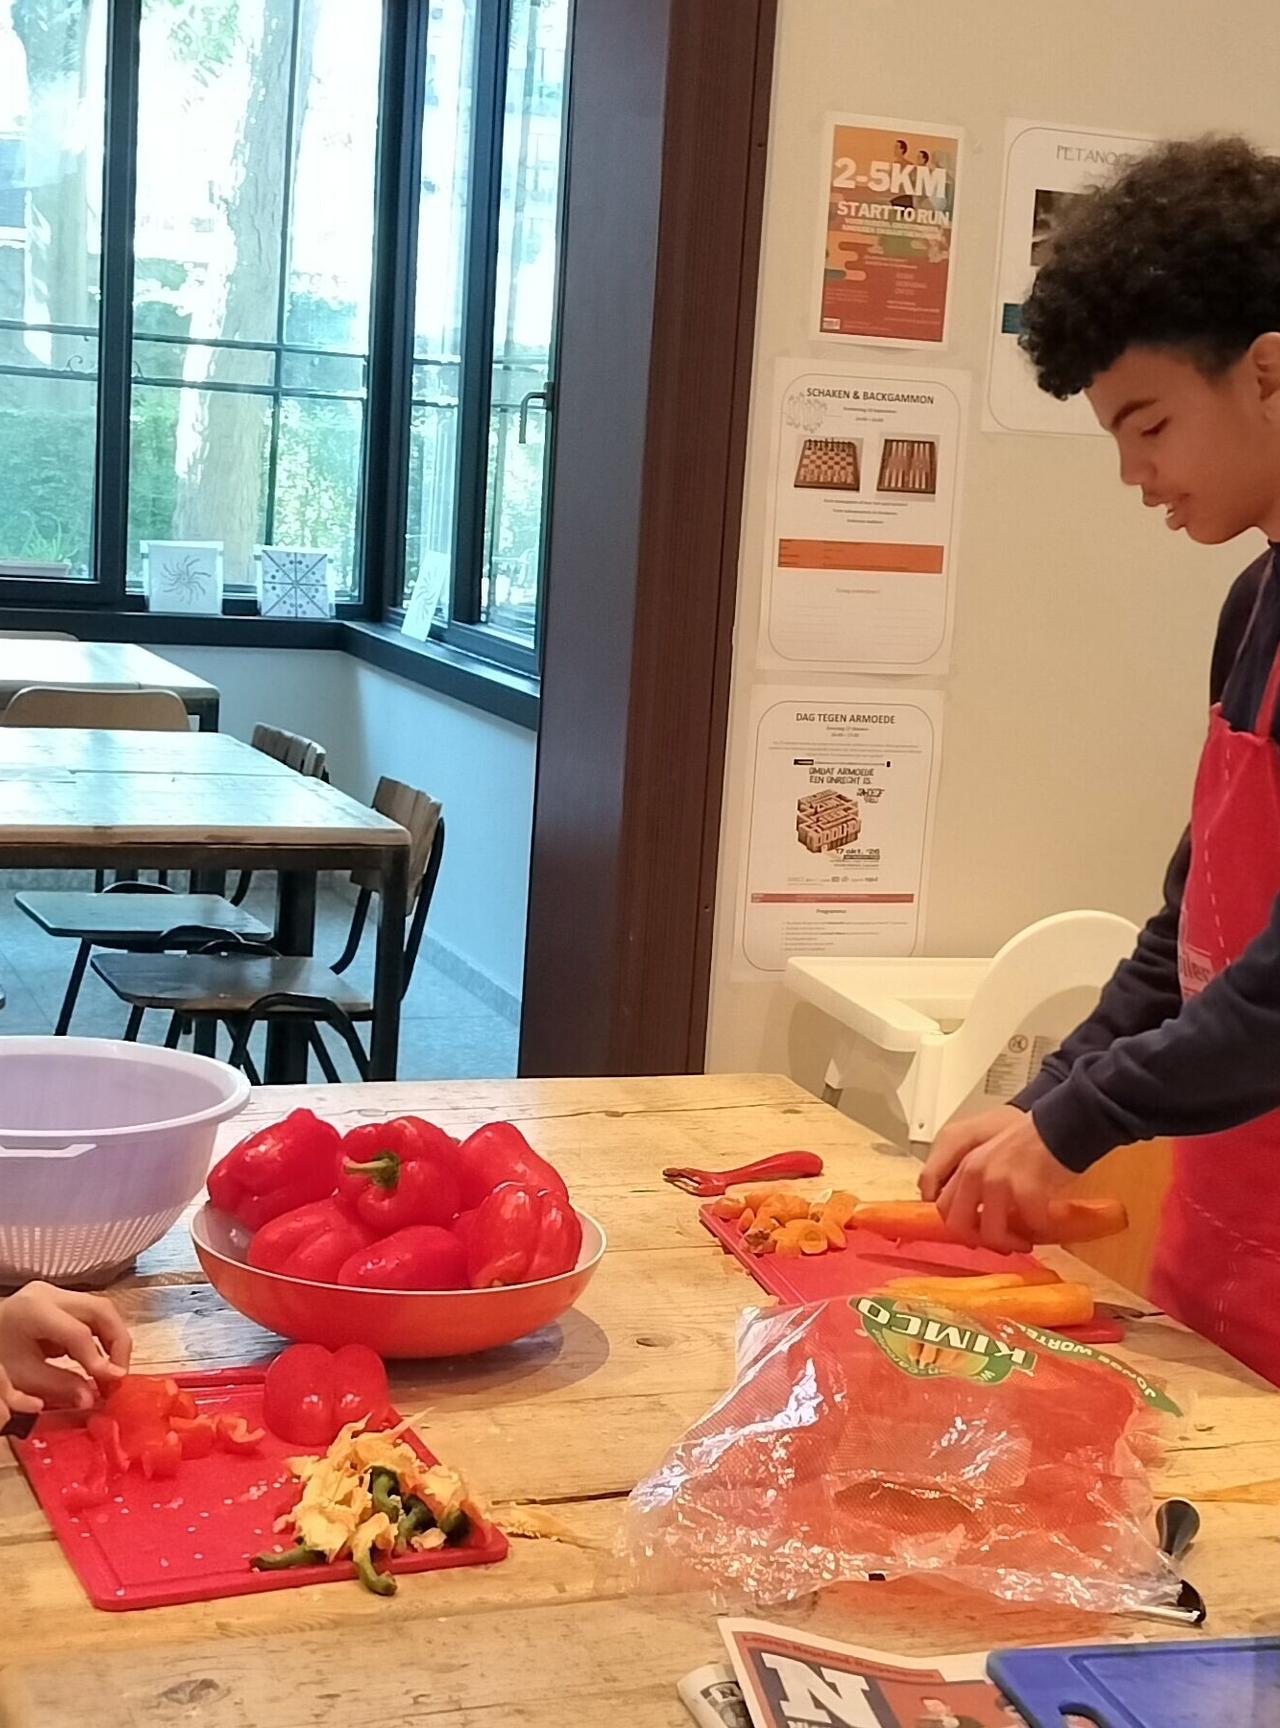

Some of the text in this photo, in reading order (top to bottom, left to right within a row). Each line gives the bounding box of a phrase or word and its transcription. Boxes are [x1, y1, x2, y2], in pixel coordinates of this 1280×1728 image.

[1056, 144, 1119, 166] PETANQ
[832, 157, 947, 198] 2-5KM
[837, 201, 950, 226] START TO RUN
[807, 388, 934, 404] SCHAKEN & BACKGAMMON
[795, 712, 896, 724] DAG TEGEN ARMOEDE
[858, 1298, 1026, 1365] KIMCO
[1016, 1322, 1092, 1356] WORTE
